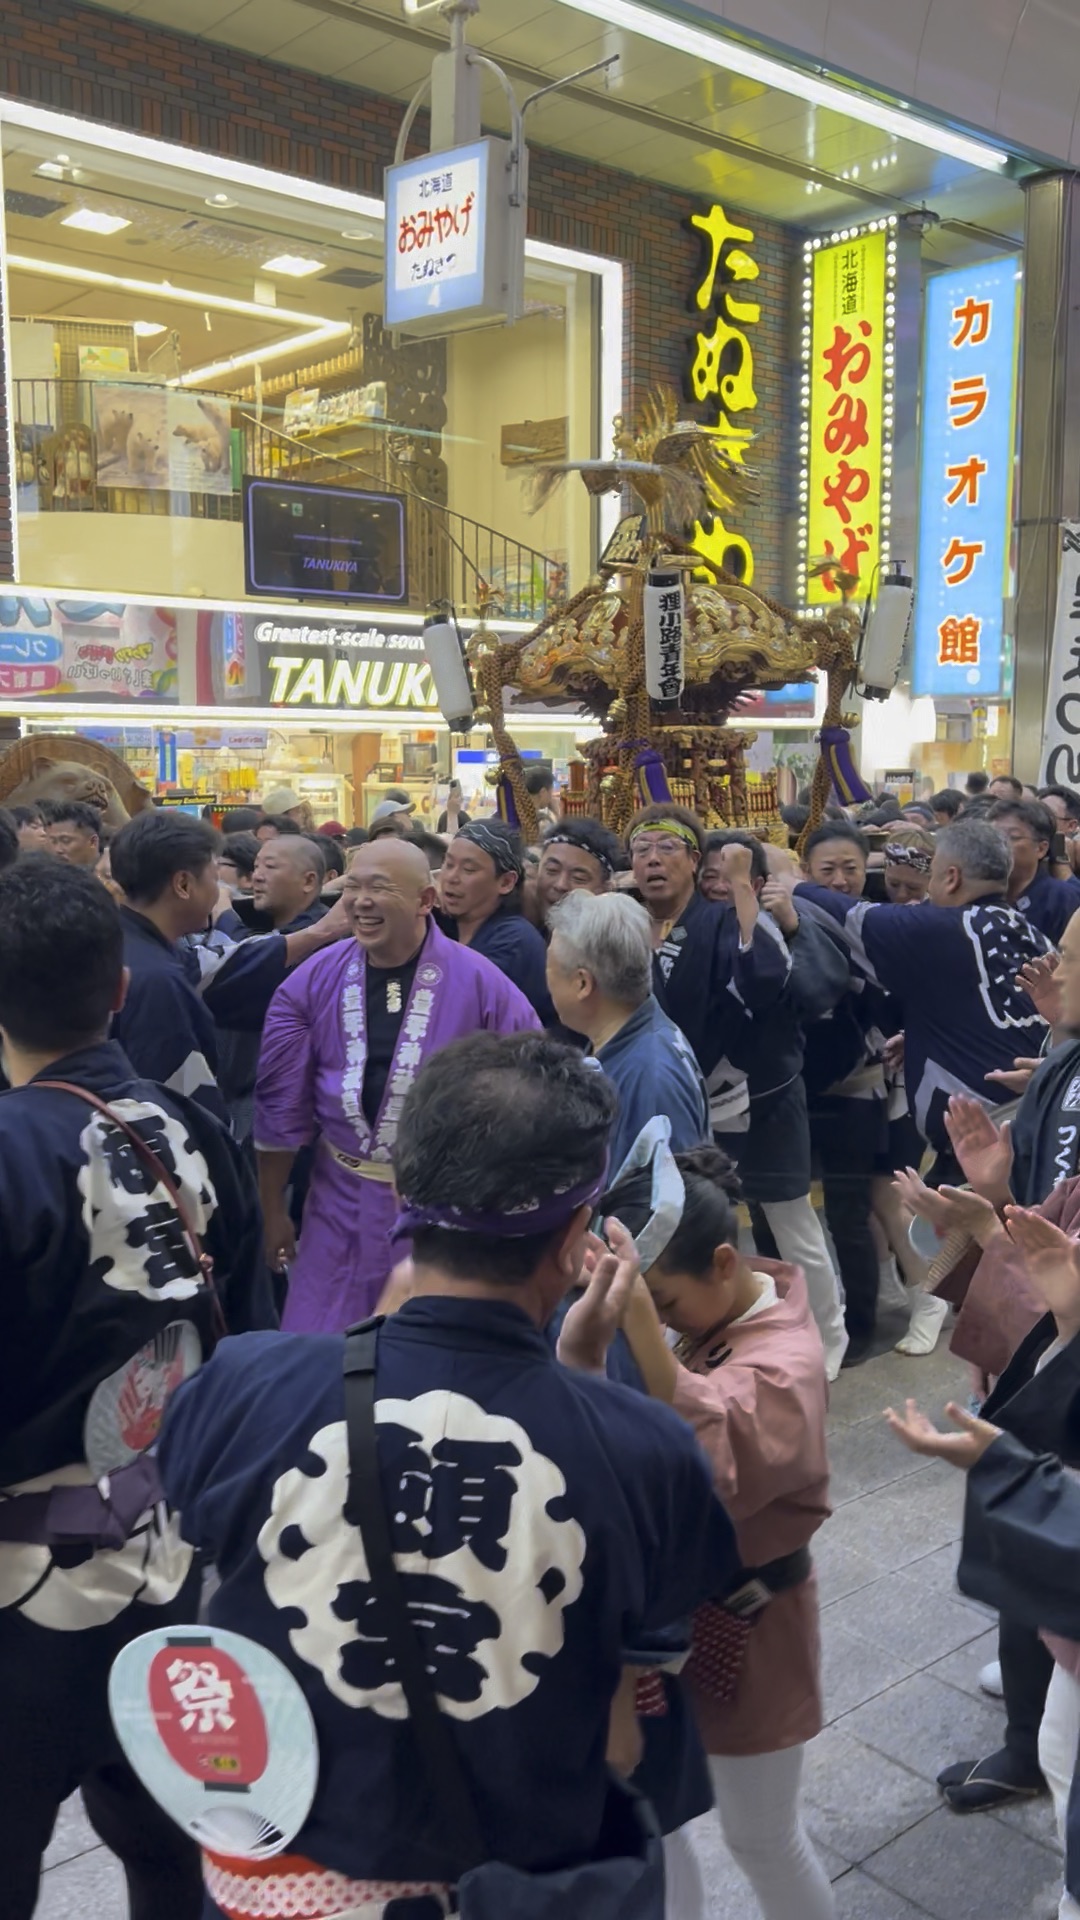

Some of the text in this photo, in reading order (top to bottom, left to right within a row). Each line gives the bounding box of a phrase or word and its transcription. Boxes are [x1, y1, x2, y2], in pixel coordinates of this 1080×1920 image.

[418, 172, 453, 198] 北海道
[398, 191, 475, 253] おみやげ
[841, 248, 859, 316] 北海道
[823, 319, 873, 594] おみやげ
[937, 296, 992, 666] カラオケ館
[302, 556, 358, 573] TANUKIYA
[254, 621, 386, 649] Greatest-scale
[166, 1658, 236, 1733] 祭
